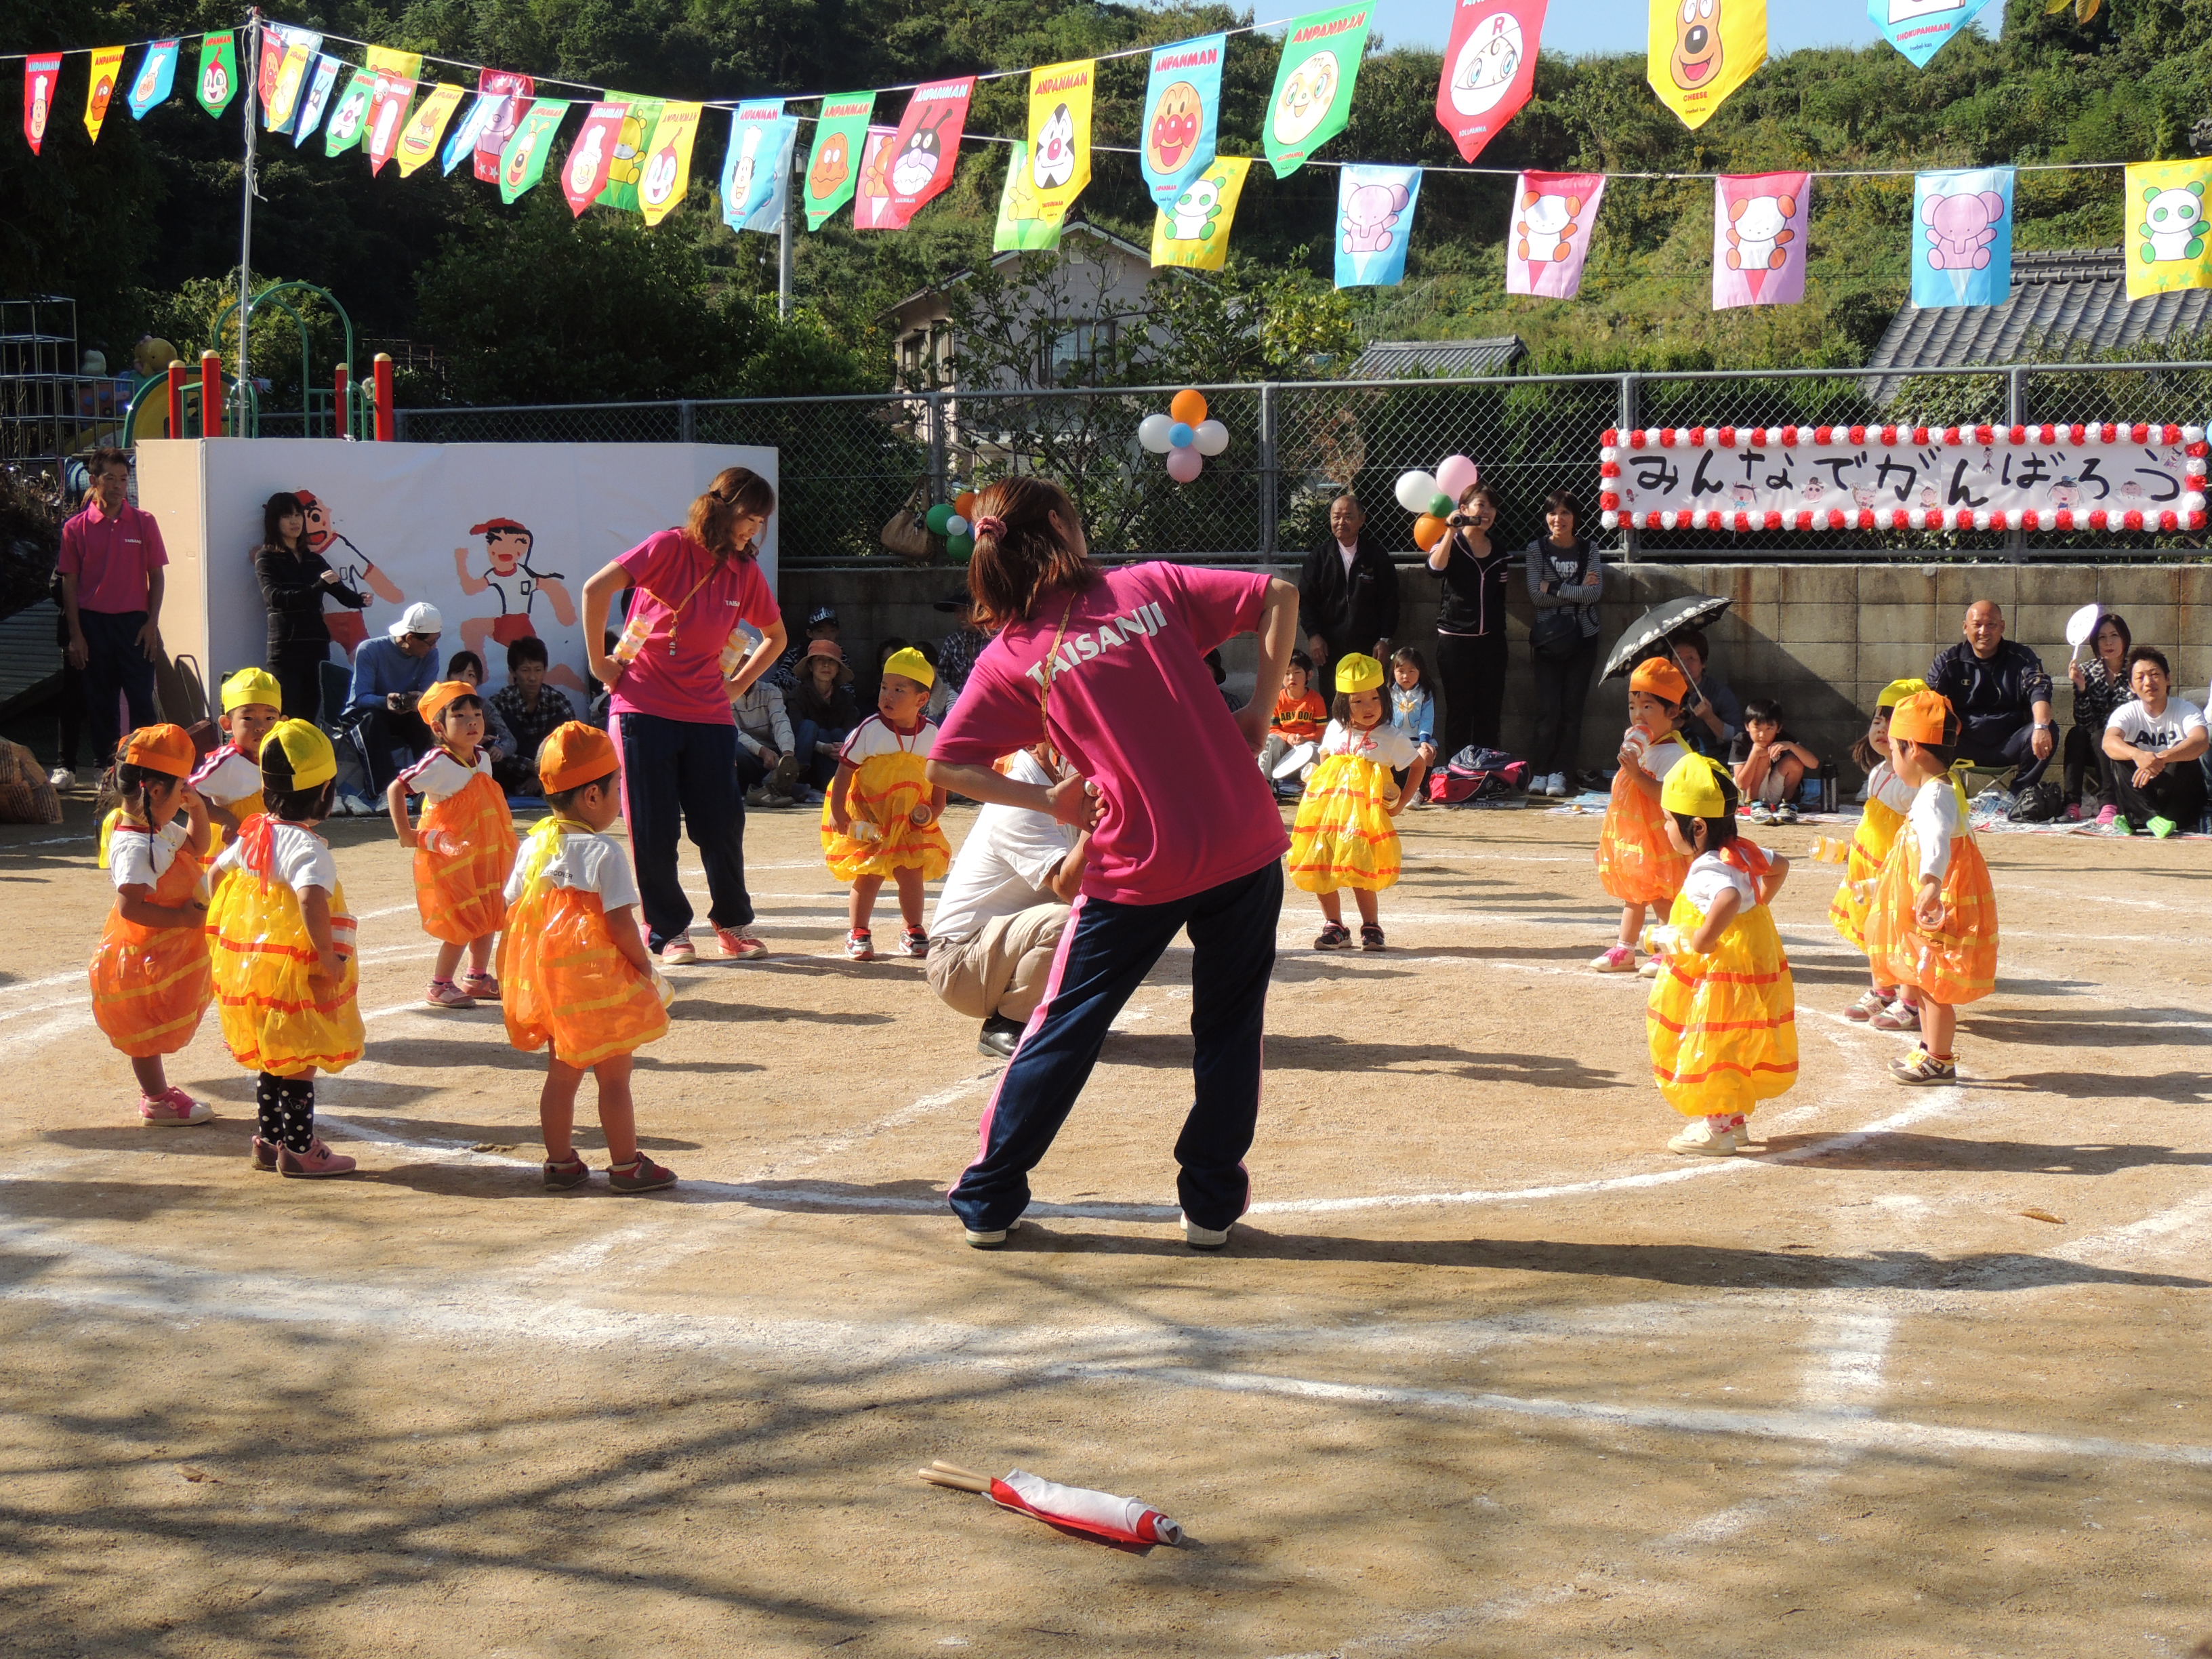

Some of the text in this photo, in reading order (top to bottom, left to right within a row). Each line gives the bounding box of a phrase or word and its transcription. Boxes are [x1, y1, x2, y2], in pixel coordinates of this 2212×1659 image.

[1291, 12, 1367, 43] ANPANMAN
[1896, 22, 1951, 41] SHOKUPANMAN
[1154, 48, 1218, 73] ANPANMAN
[1034, 71, 1088, 95] ANPANMAN
[914, 84, 968, 103] ANPANMAN
[1683, 91, 1708, 102] CHEESE
[739, 108, 779, 121] ANPANMAN
[823, 102, 871, 118] ANPANMAN
[1629, 445, 2180, 508] みんなでがんばろう
[1025, 601, 1168, 687] TAISANJI
[2133, 729, 2177, 746] ANAP
